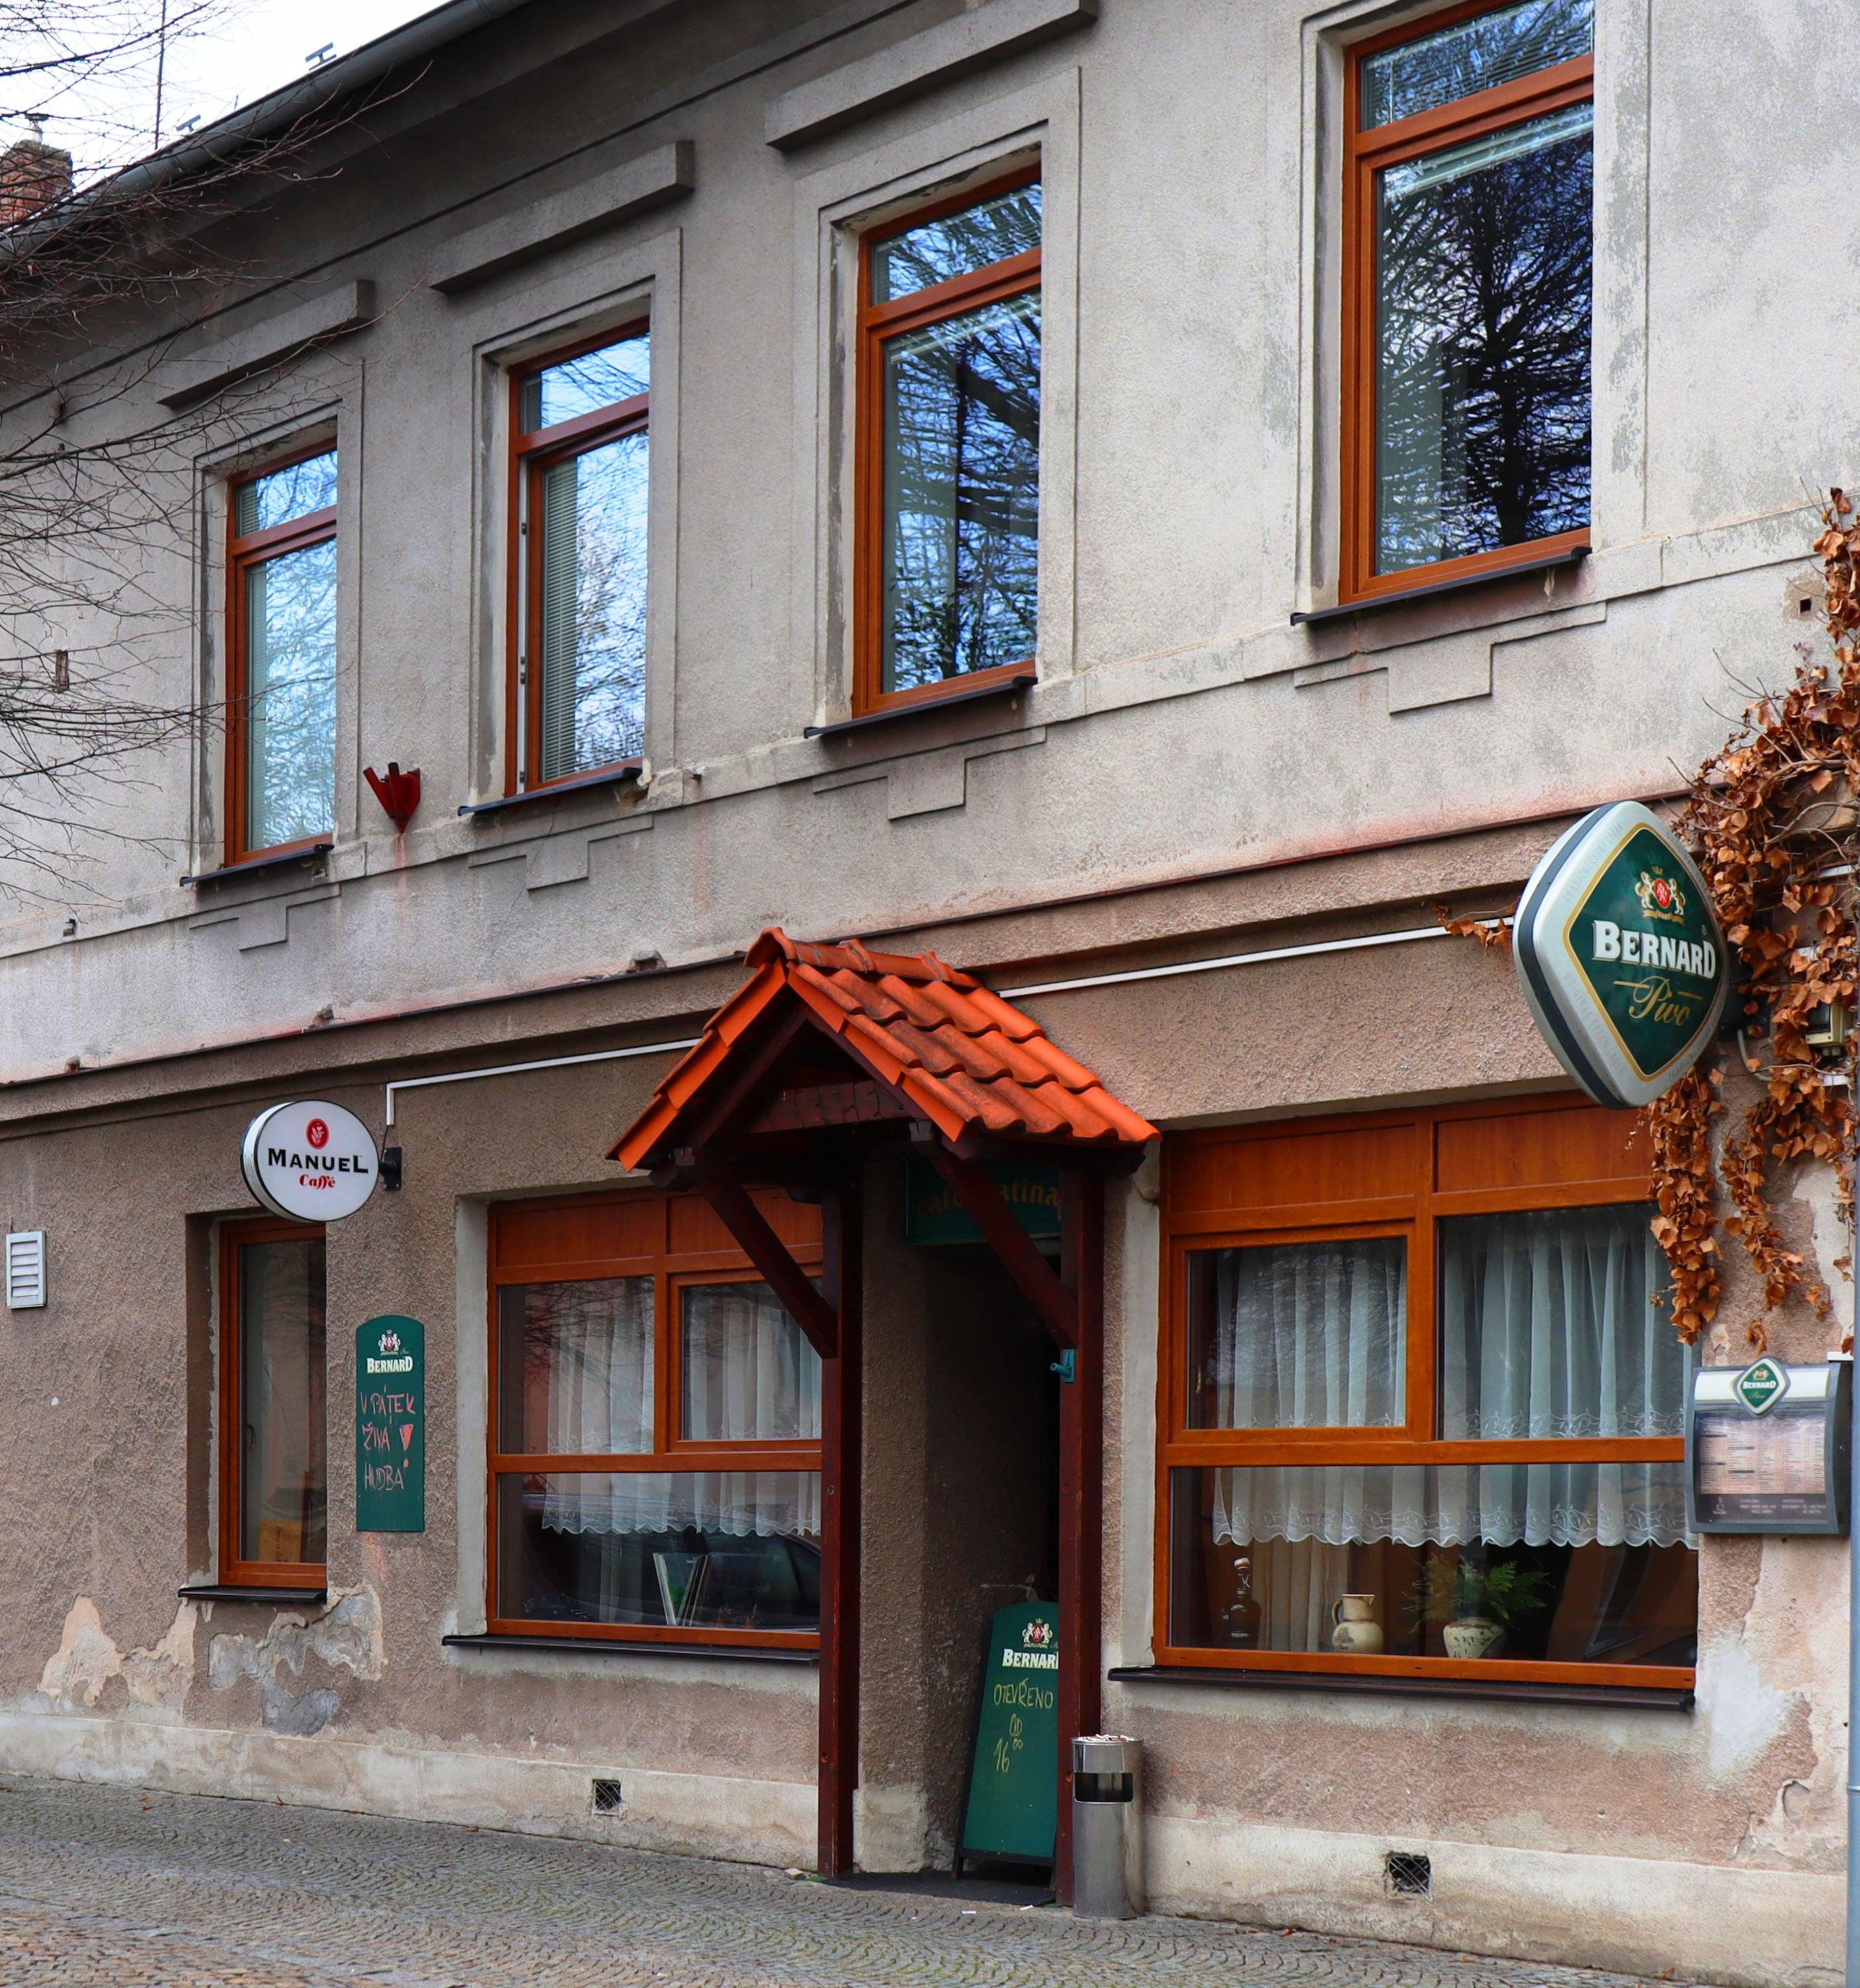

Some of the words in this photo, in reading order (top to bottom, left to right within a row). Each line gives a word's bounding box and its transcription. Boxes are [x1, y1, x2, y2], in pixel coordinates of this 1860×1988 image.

[1592, 920, 1716, 979] BERNARD
[268, 1148, 368, 1174] MANUEL
[999, 1178, 1060, 1208] atina
[366, 1356, 413, 1374] BERNARD
[1743, 1380, 1776, 1390] BERNARD
[360, 1392, 367, 1415] V
[364, 1463, 404, 1490] HUDBA
[1009, 1713, 1023, 1736] OD
